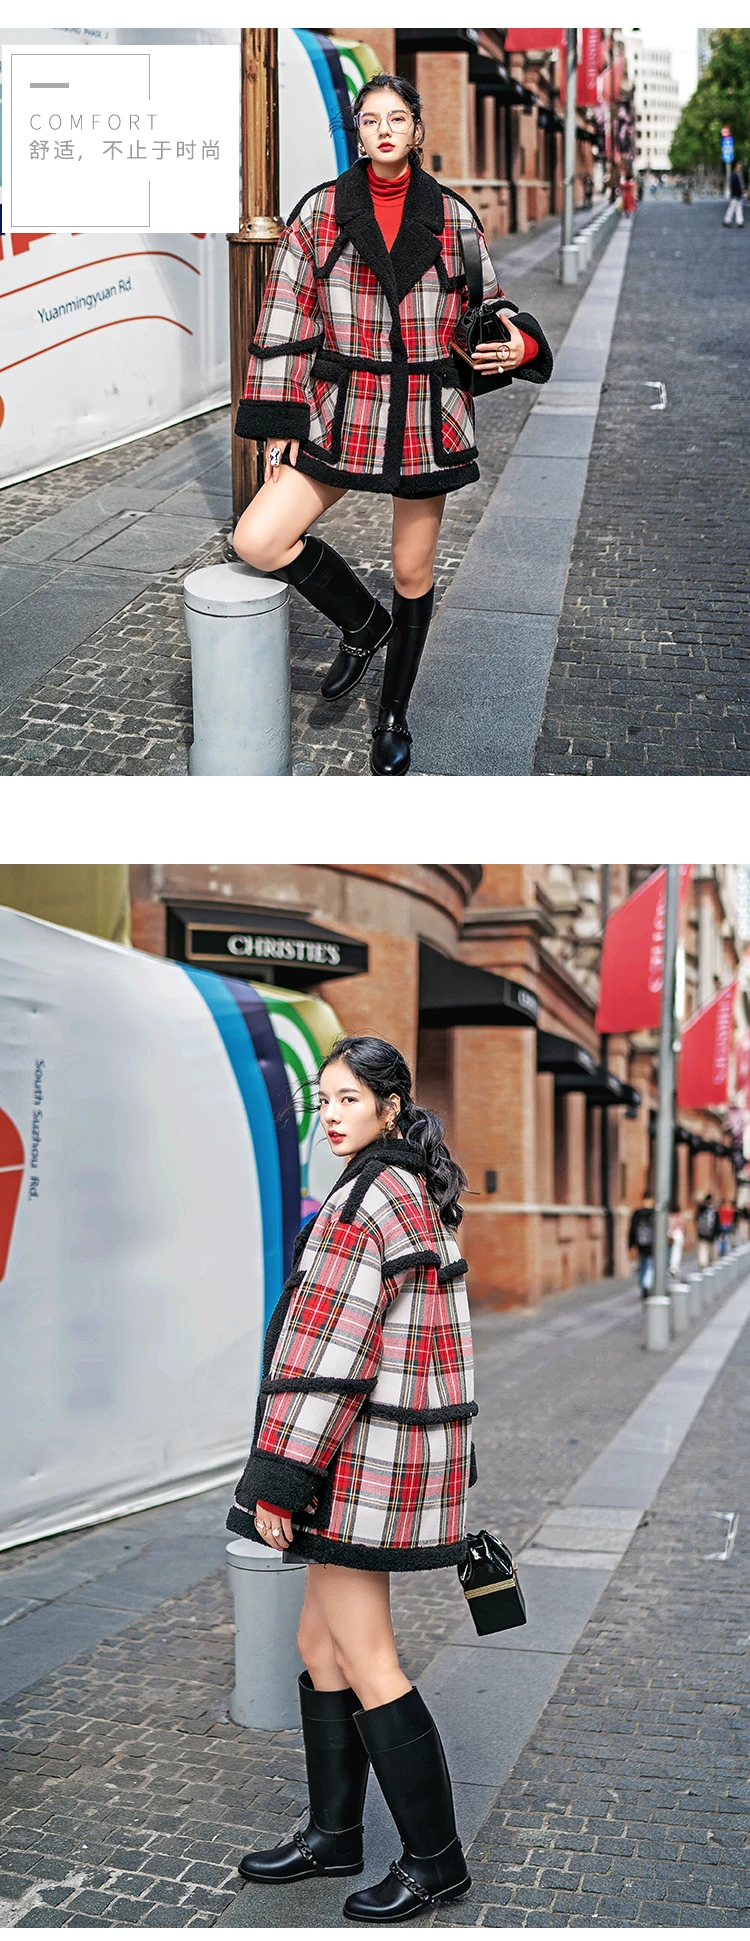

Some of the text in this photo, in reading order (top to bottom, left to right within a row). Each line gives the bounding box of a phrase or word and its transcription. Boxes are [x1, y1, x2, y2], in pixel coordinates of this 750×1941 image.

[37, 276, 135, 324] Yuanmingyuan Rd.
[227, 934, 341, 966] CHRISTIE'S
[28, 1058, 46, 1202] South Suzhou Rd.
